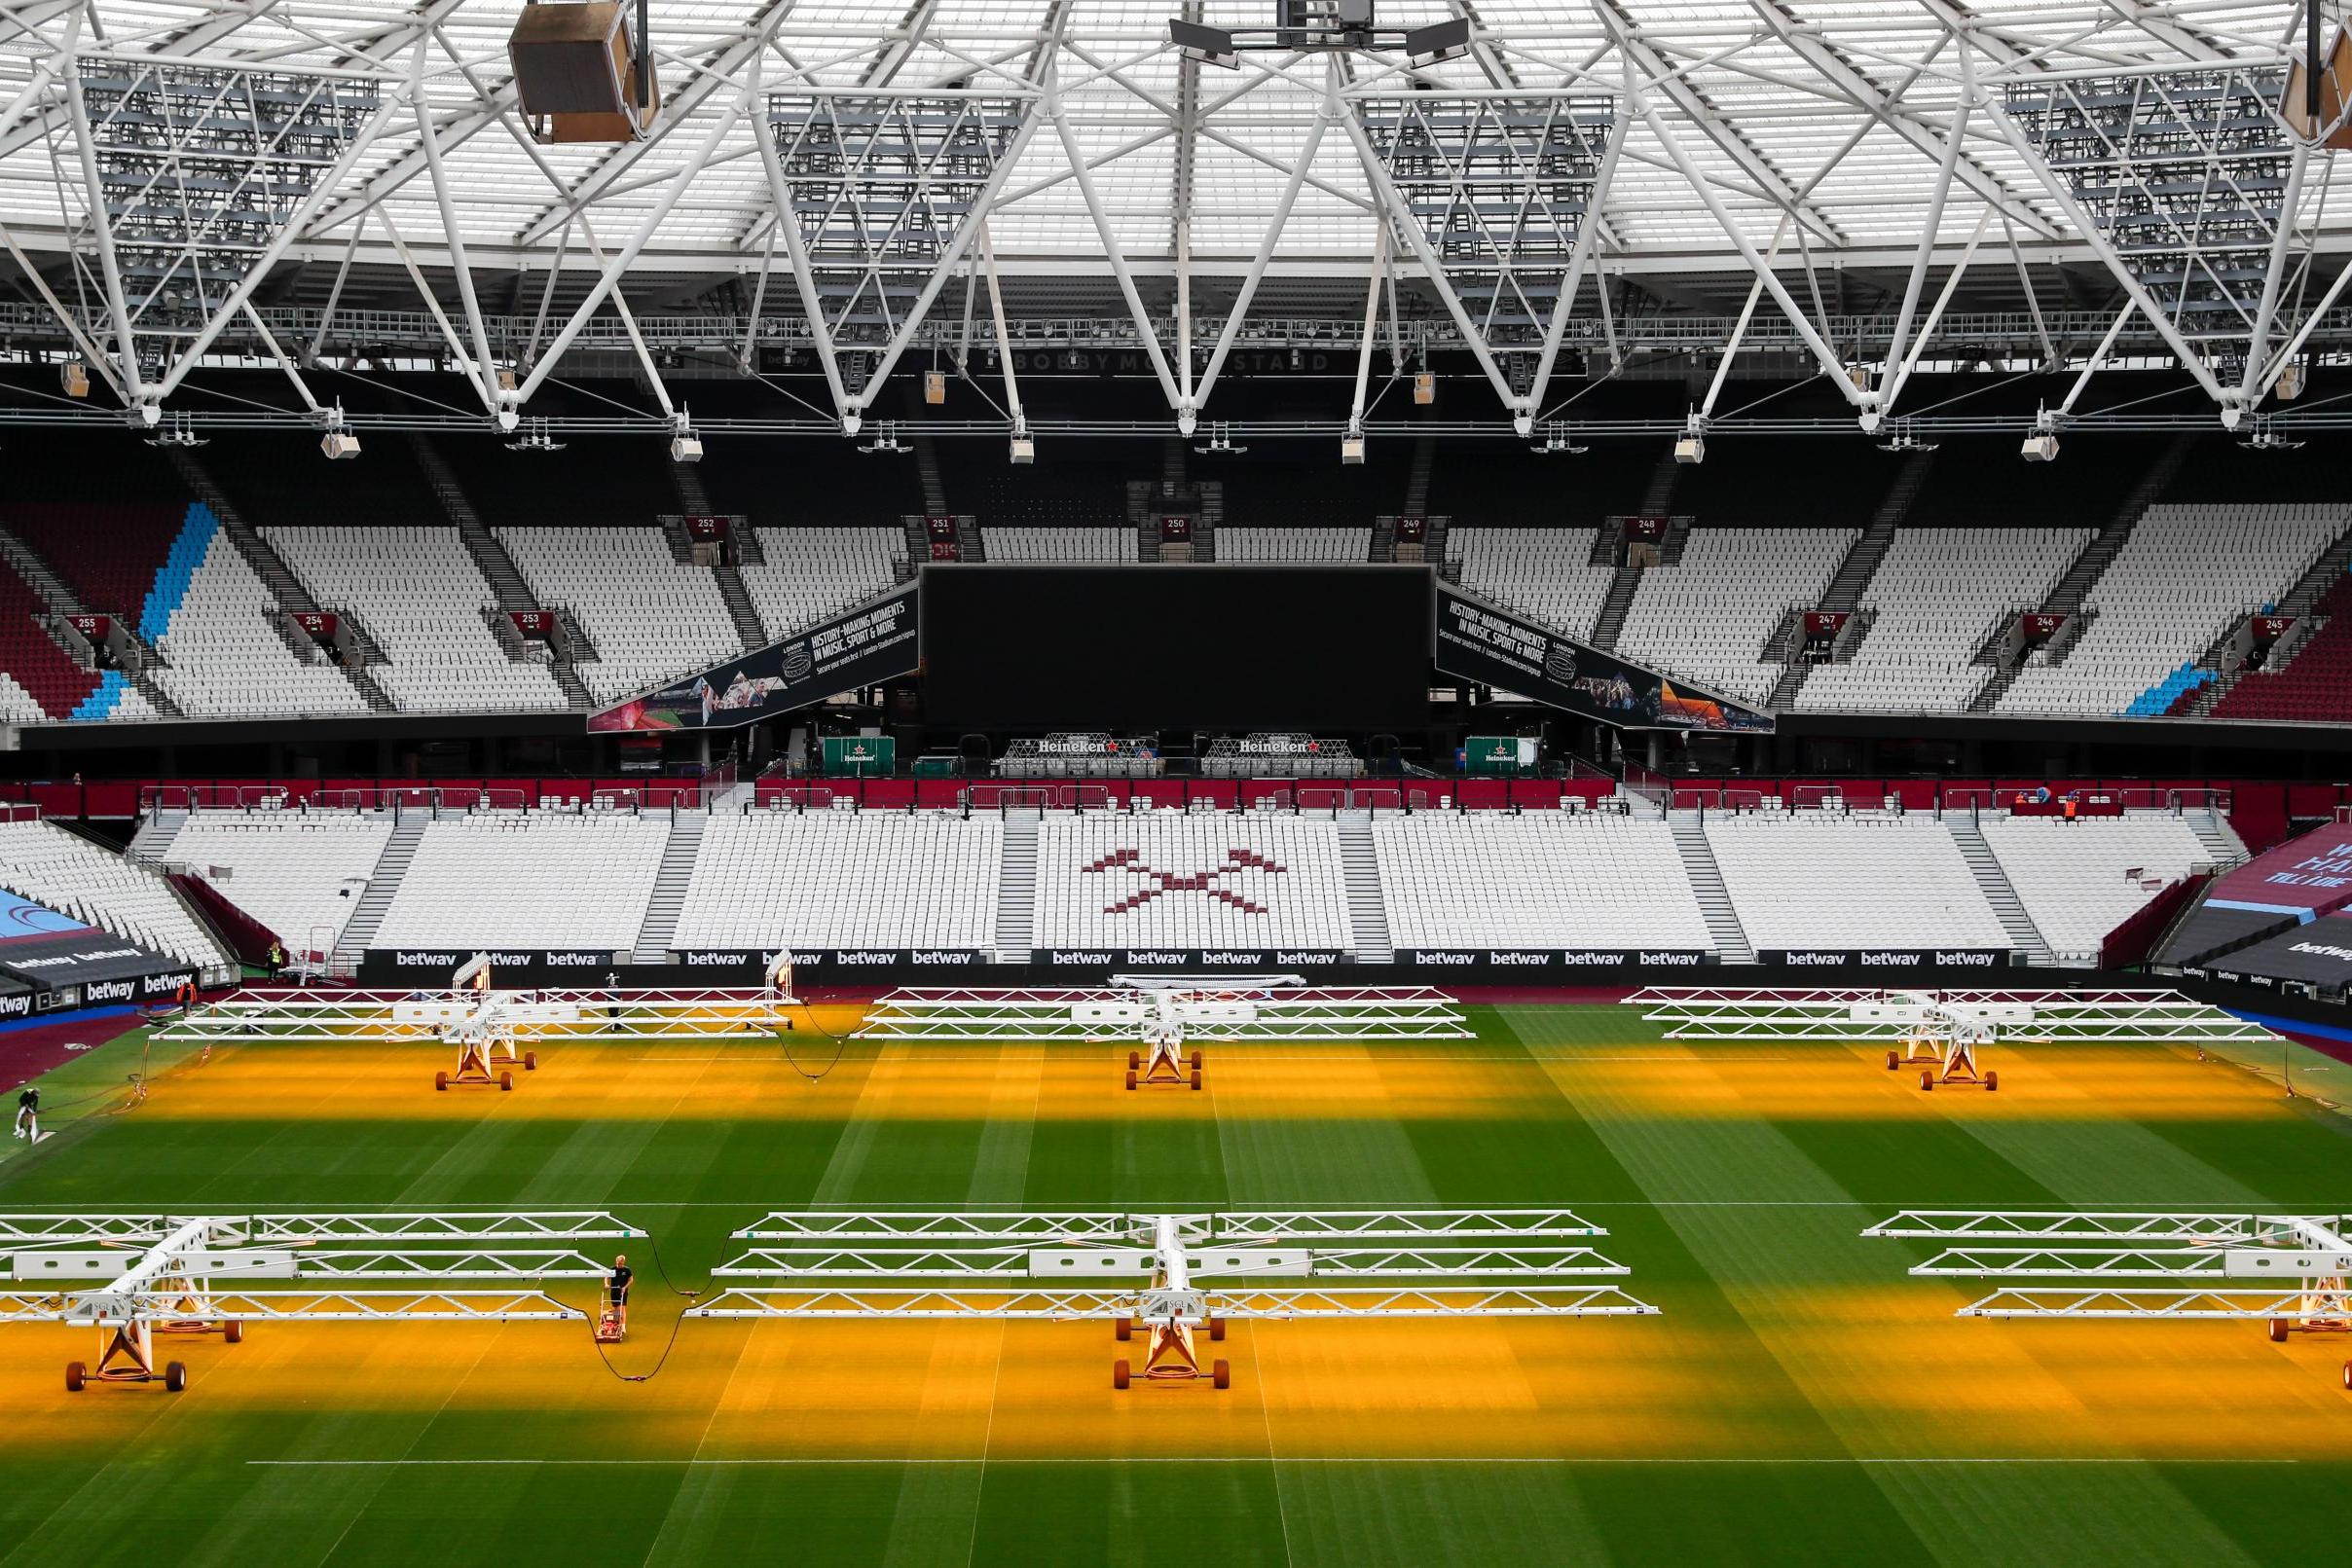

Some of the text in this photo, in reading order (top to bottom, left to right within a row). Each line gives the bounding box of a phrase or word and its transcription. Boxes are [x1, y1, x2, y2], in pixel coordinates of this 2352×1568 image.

[697, 519, 715, 528] 252
[933, 519, 949, 528] 251
[1167, 519, 1185, 528] 250
[1403, 519, 1420, 528] 249
[1638, 520, 1655, 529] 248
[78, 618, 95, 628] 255
[306, 615, 322, 625] 254
[522, 614, 539, 623] 253
[811, 601, 905, 649] HISTORY-MAKING MOMENTS
[1819, 615, 1836, 624] 247
[2037, 617, 2054, 626] 246
[2266, 620, 2283, 629] 245
[1450, 601, 1547, 650] HISTORY-MAKING MOMENTS
[813, 648, 822, 662] IN
[846, 629, 870, 649] SPORT
[876, 618, 897, 637] MORE
[1458, 618, 1467, 631] IN
[1491, 633, 1517, 652] SPORT
[1523, 645, 1545, 664] MORE
[783, 640, 805, 654] LONDON
[1553, 641, 1576, 655] LONDON
[1039, 740, 1106, 753] Heineken
[1240, 740, 1306, 753] Heineken
[397, 951, 457, 966] betway
[547, 951, 606, 966] betwa
[687, 951, 748, 966] betway
[837, 951, 897, 966] betway
[912, 951, 972, 966] betway
[1052, 951, 1336, 966] betway betway betway betway
[1415, 951, 1699, 966] betway betway betway betway
[1786, 951, 1995, 966] betway betway betway
[2184, 966, 2205, 978] betway
[2218, 970, 2239, 982] betway
[2251, 975, 2272, 987] betway
[88, 981, 135, 1001] betway
